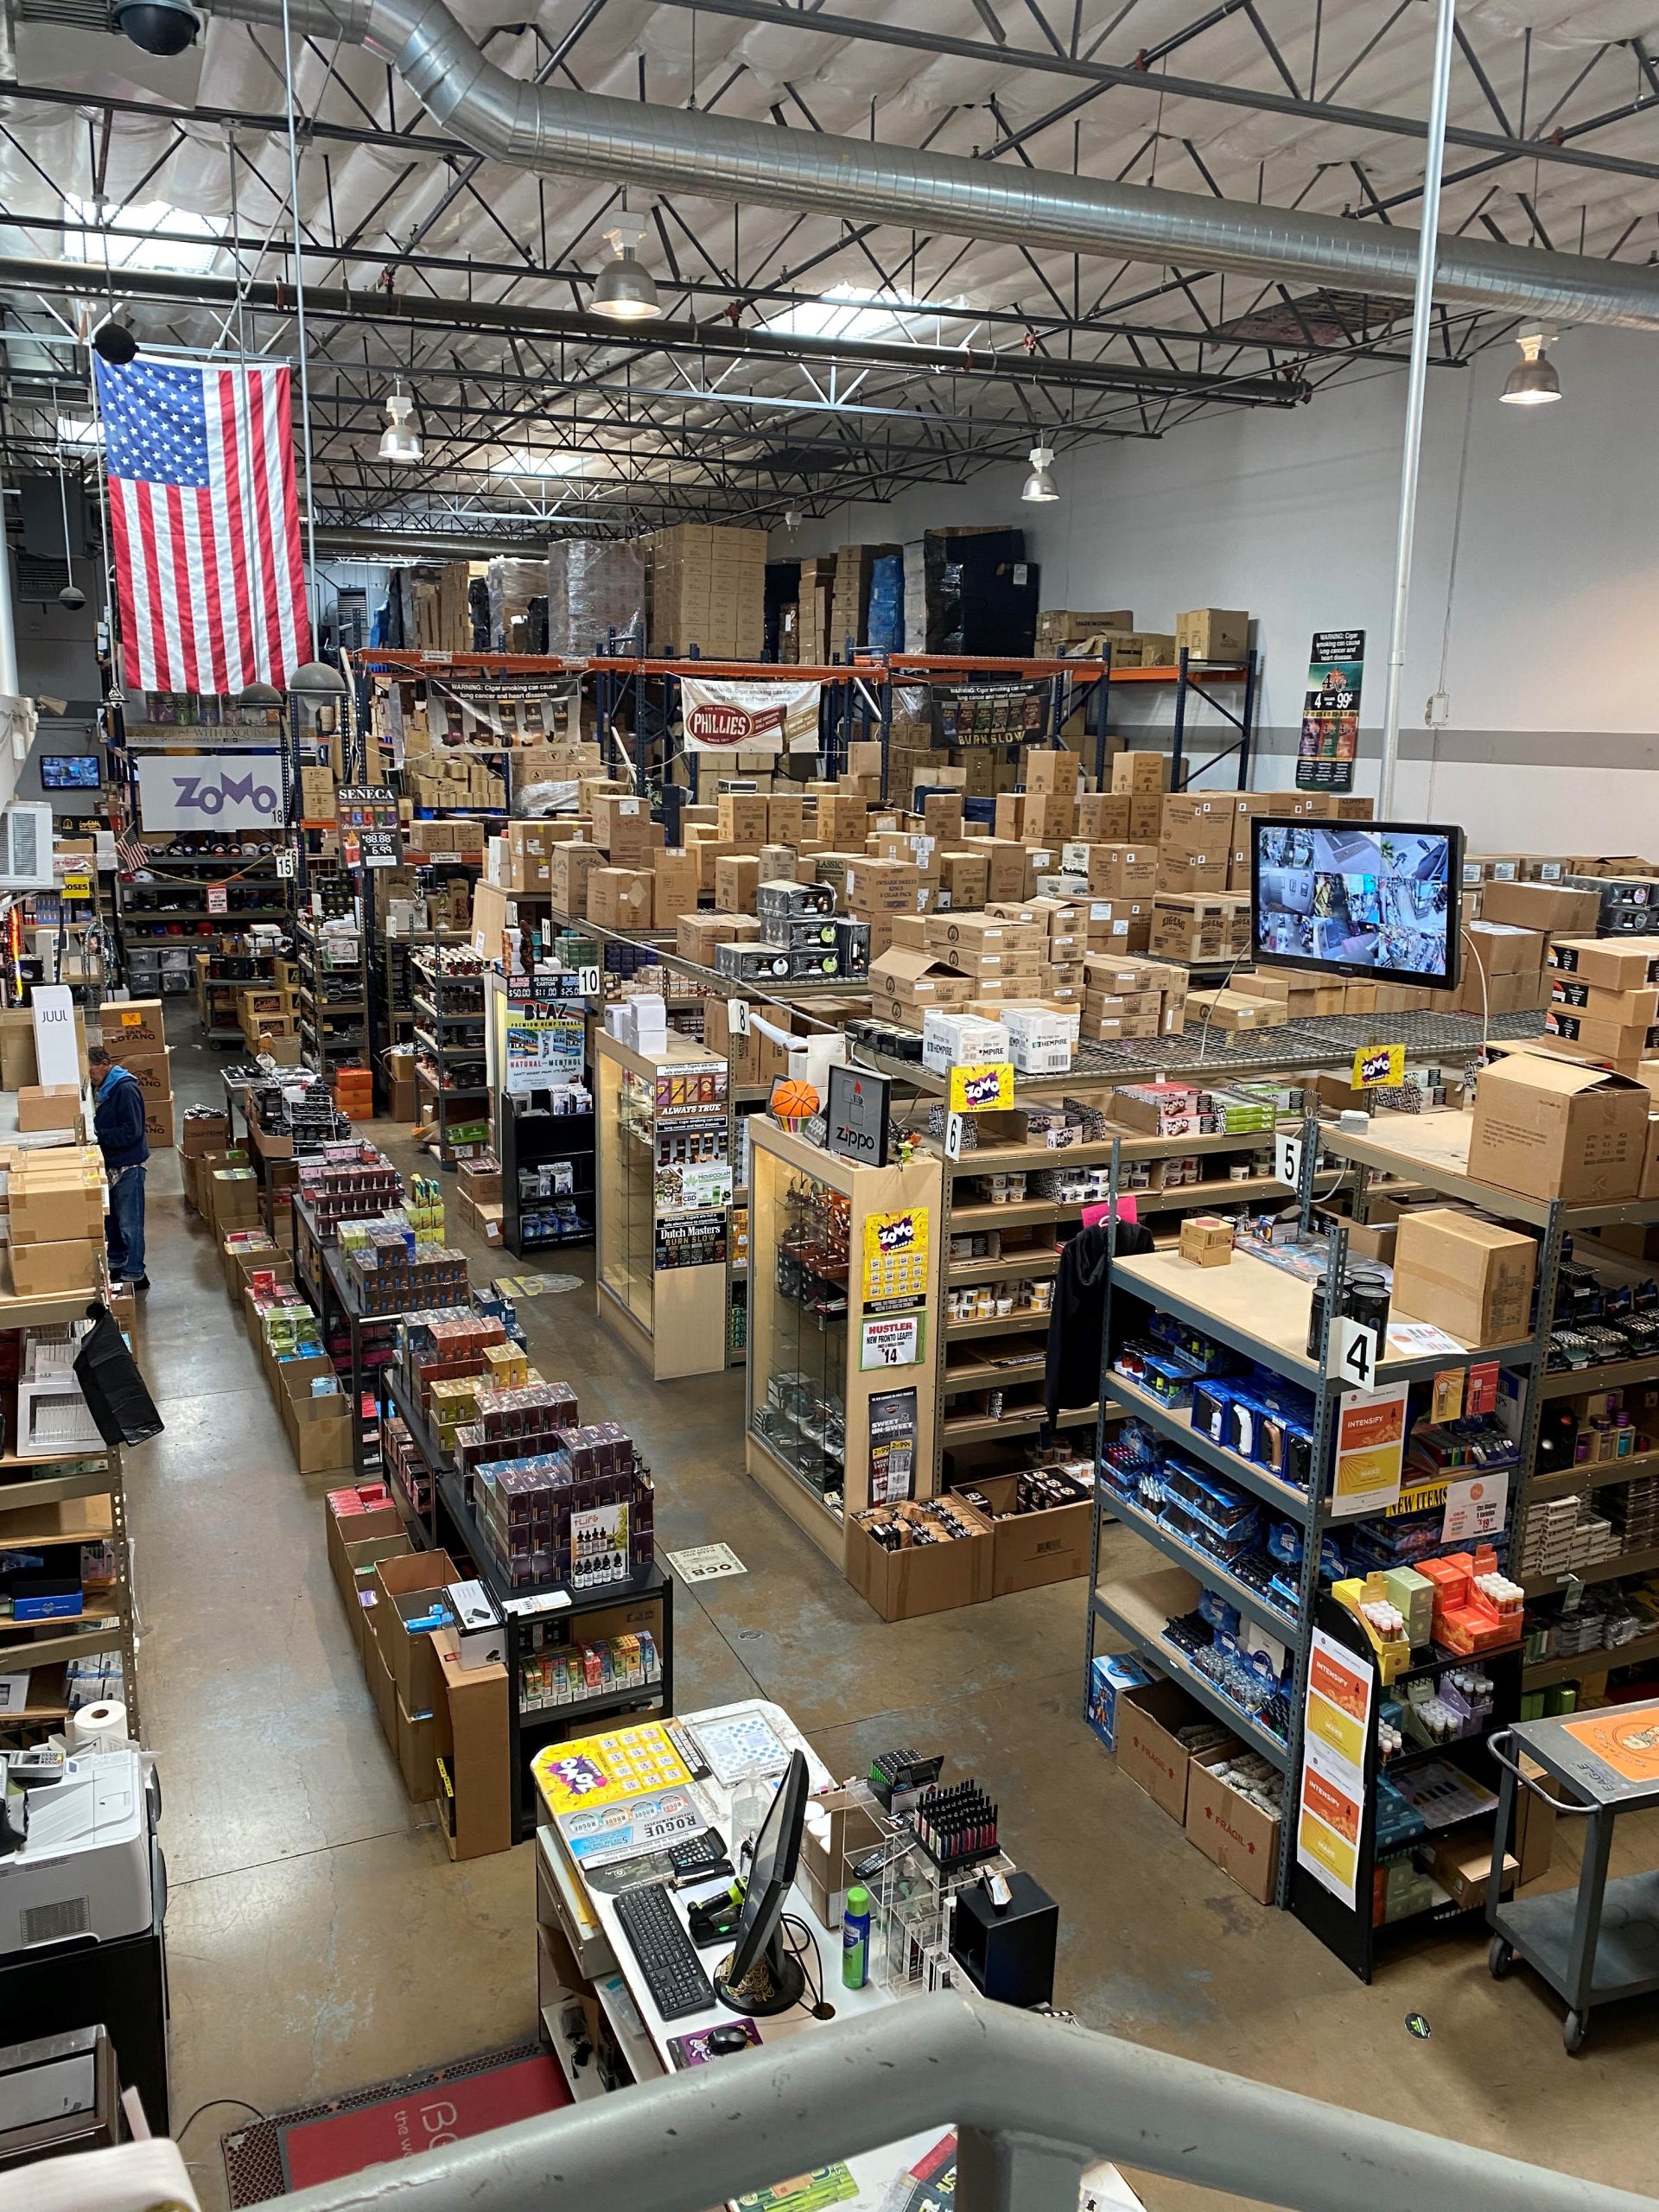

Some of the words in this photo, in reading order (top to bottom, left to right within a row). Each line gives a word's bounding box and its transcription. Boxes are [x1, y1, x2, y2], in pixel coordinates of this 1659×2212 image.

[694, 713, 746, 735] PHILLIES
[958, 735, 988, 744] BURN
[992, 731, 1025, 744] SLOW
[172, 772, 277, 814] ZOMO
[339, 788, 394, 800] SENECA
[272, 810, 283, 823] 18
[279, 858, 292, 874] 15
[582, 969, 597, 992] 10
[42, 1010, 68, 1023] JUUL
[740, 1005, 746, 1031] 8
[1041, 1039, 1068, 1047] HEMPIRE
[965, 1078, 999, 1099] ZOMO
[661, 1106, 696, 1115] ALWAYS
[950, 1119, 957, 1153] 6
[1284, 1144, 1294, 1180] 5
[661, 1229, 686, 1239] Dutch
[687, 1226, 720, 1236] Masters
[879, 1223, 914, 1244] ZOMO
[666, 1237, 689, 1246] BURN
[692, 1234, 715, 1243] SLOW
[869, 1322, 912, 1335] HUSTLER
[867, 1335, 877, 1344] NEW
[878, 1334, 896, 1343] FRONTO
[1346, 1334, 1369, 1382] 4
[871, 1418, 899, 1428] SWEET
[871, 1422, 913, 1434] UN-SWEET
[1348, 1415, 1383, 1428] INTENSIFY
[1390, 1496, 1415, 1515] NEW
[692, 1564, 732, 1576] OCB
[1316, 1661, 1348, 1687] INTENSIFY
[1577, 1763, 1615, 1792] EAGLE
[1309, 1780, 1340, 1808] INTENSIFY
[574, 1822, 596, 1831] ROGUE
[605, 1815, 626, 1825] ROGUE
[645, 1816, 697, 1837] ROGUE
[394, 2110, 408, 2136] the
